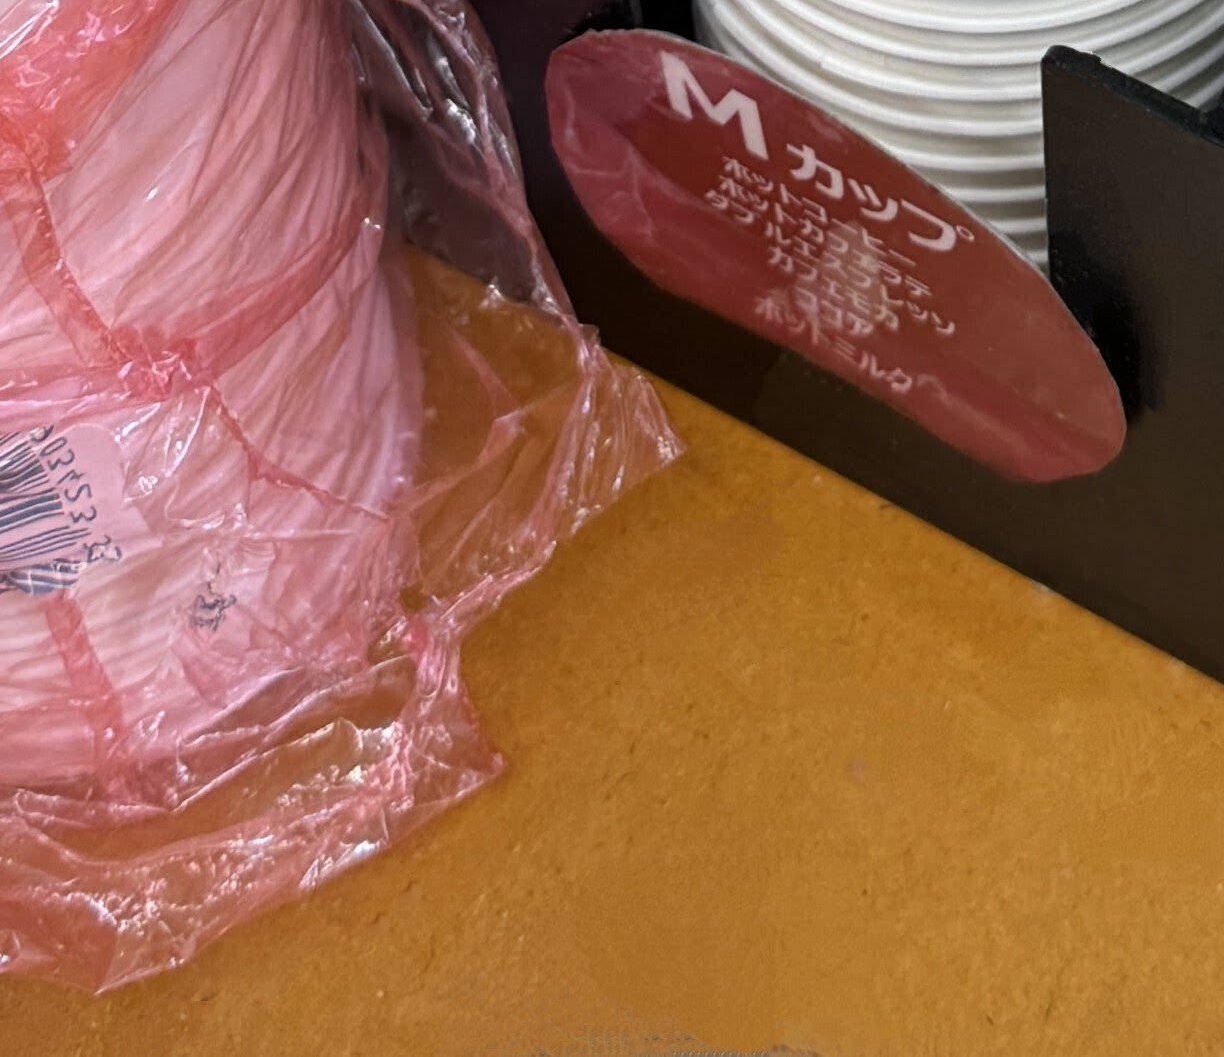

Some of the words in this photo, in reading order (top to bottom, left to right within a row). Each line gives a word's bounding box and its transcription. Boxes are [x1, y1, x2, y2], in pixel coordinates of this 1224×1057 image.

[721, 156, 917, 267] ホットコーヒー
